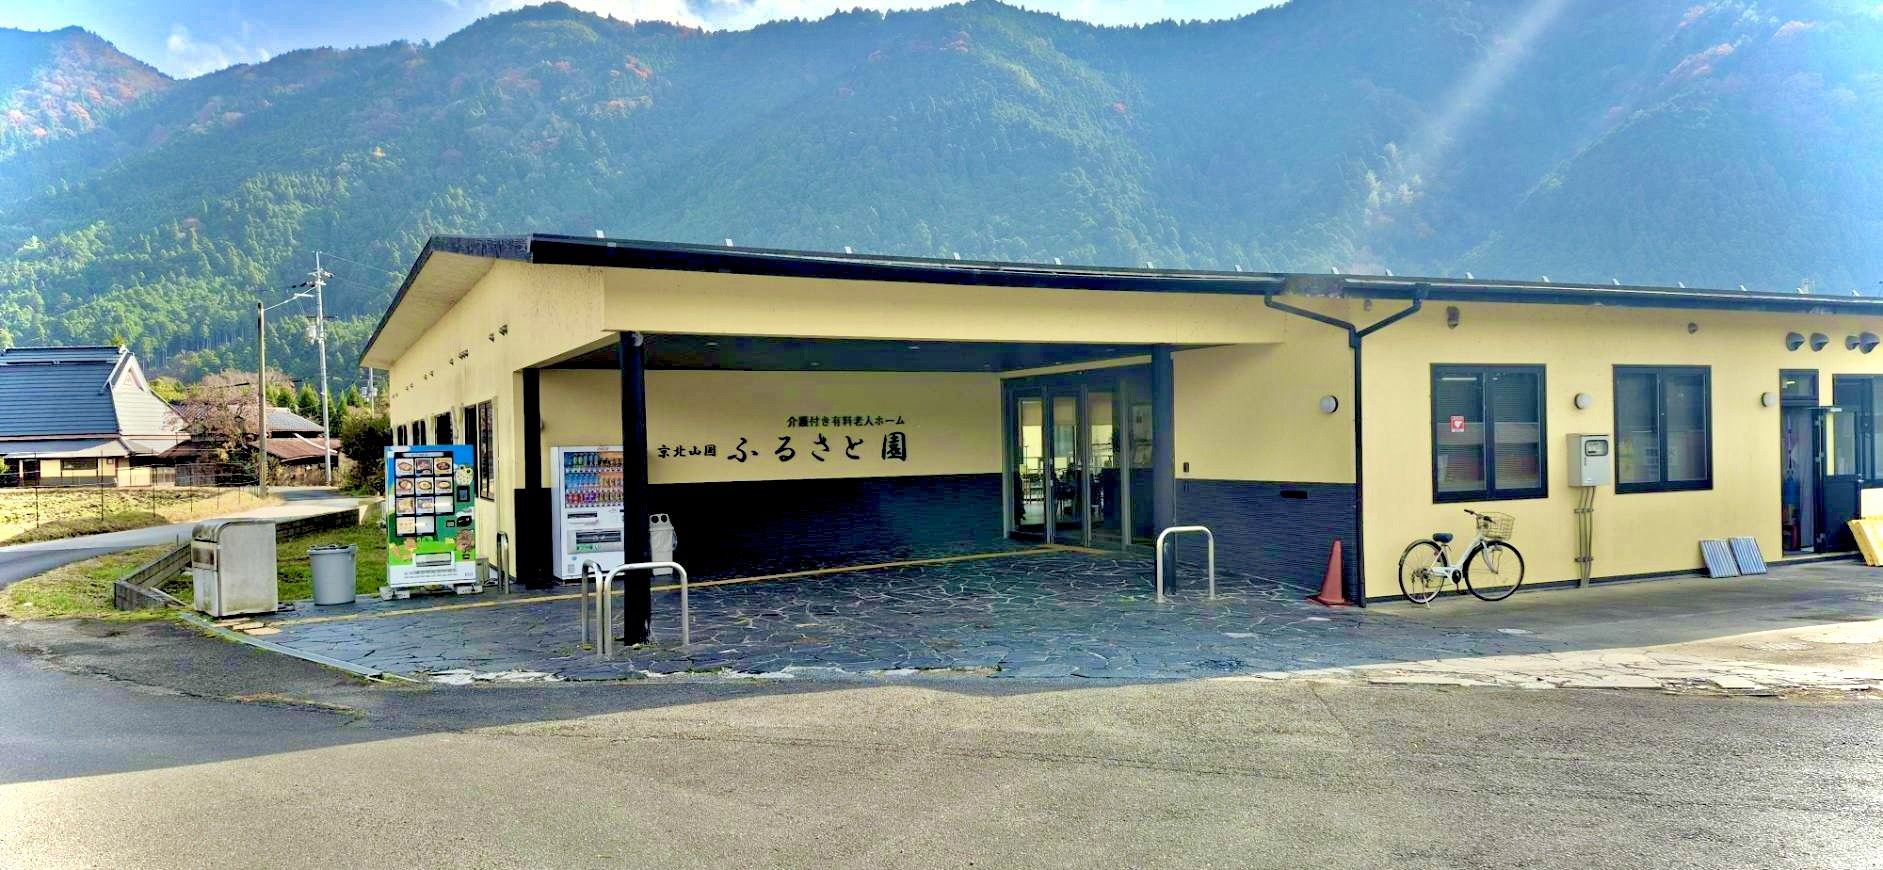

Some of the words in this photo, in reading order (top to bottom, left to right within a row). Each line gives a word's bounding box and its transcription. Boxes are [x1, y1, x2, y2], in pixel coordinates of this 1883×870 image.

[786, 415, 906, 428] 介護付き有料老人ホーム
[727, 431, 908, 463] ふるさと園
